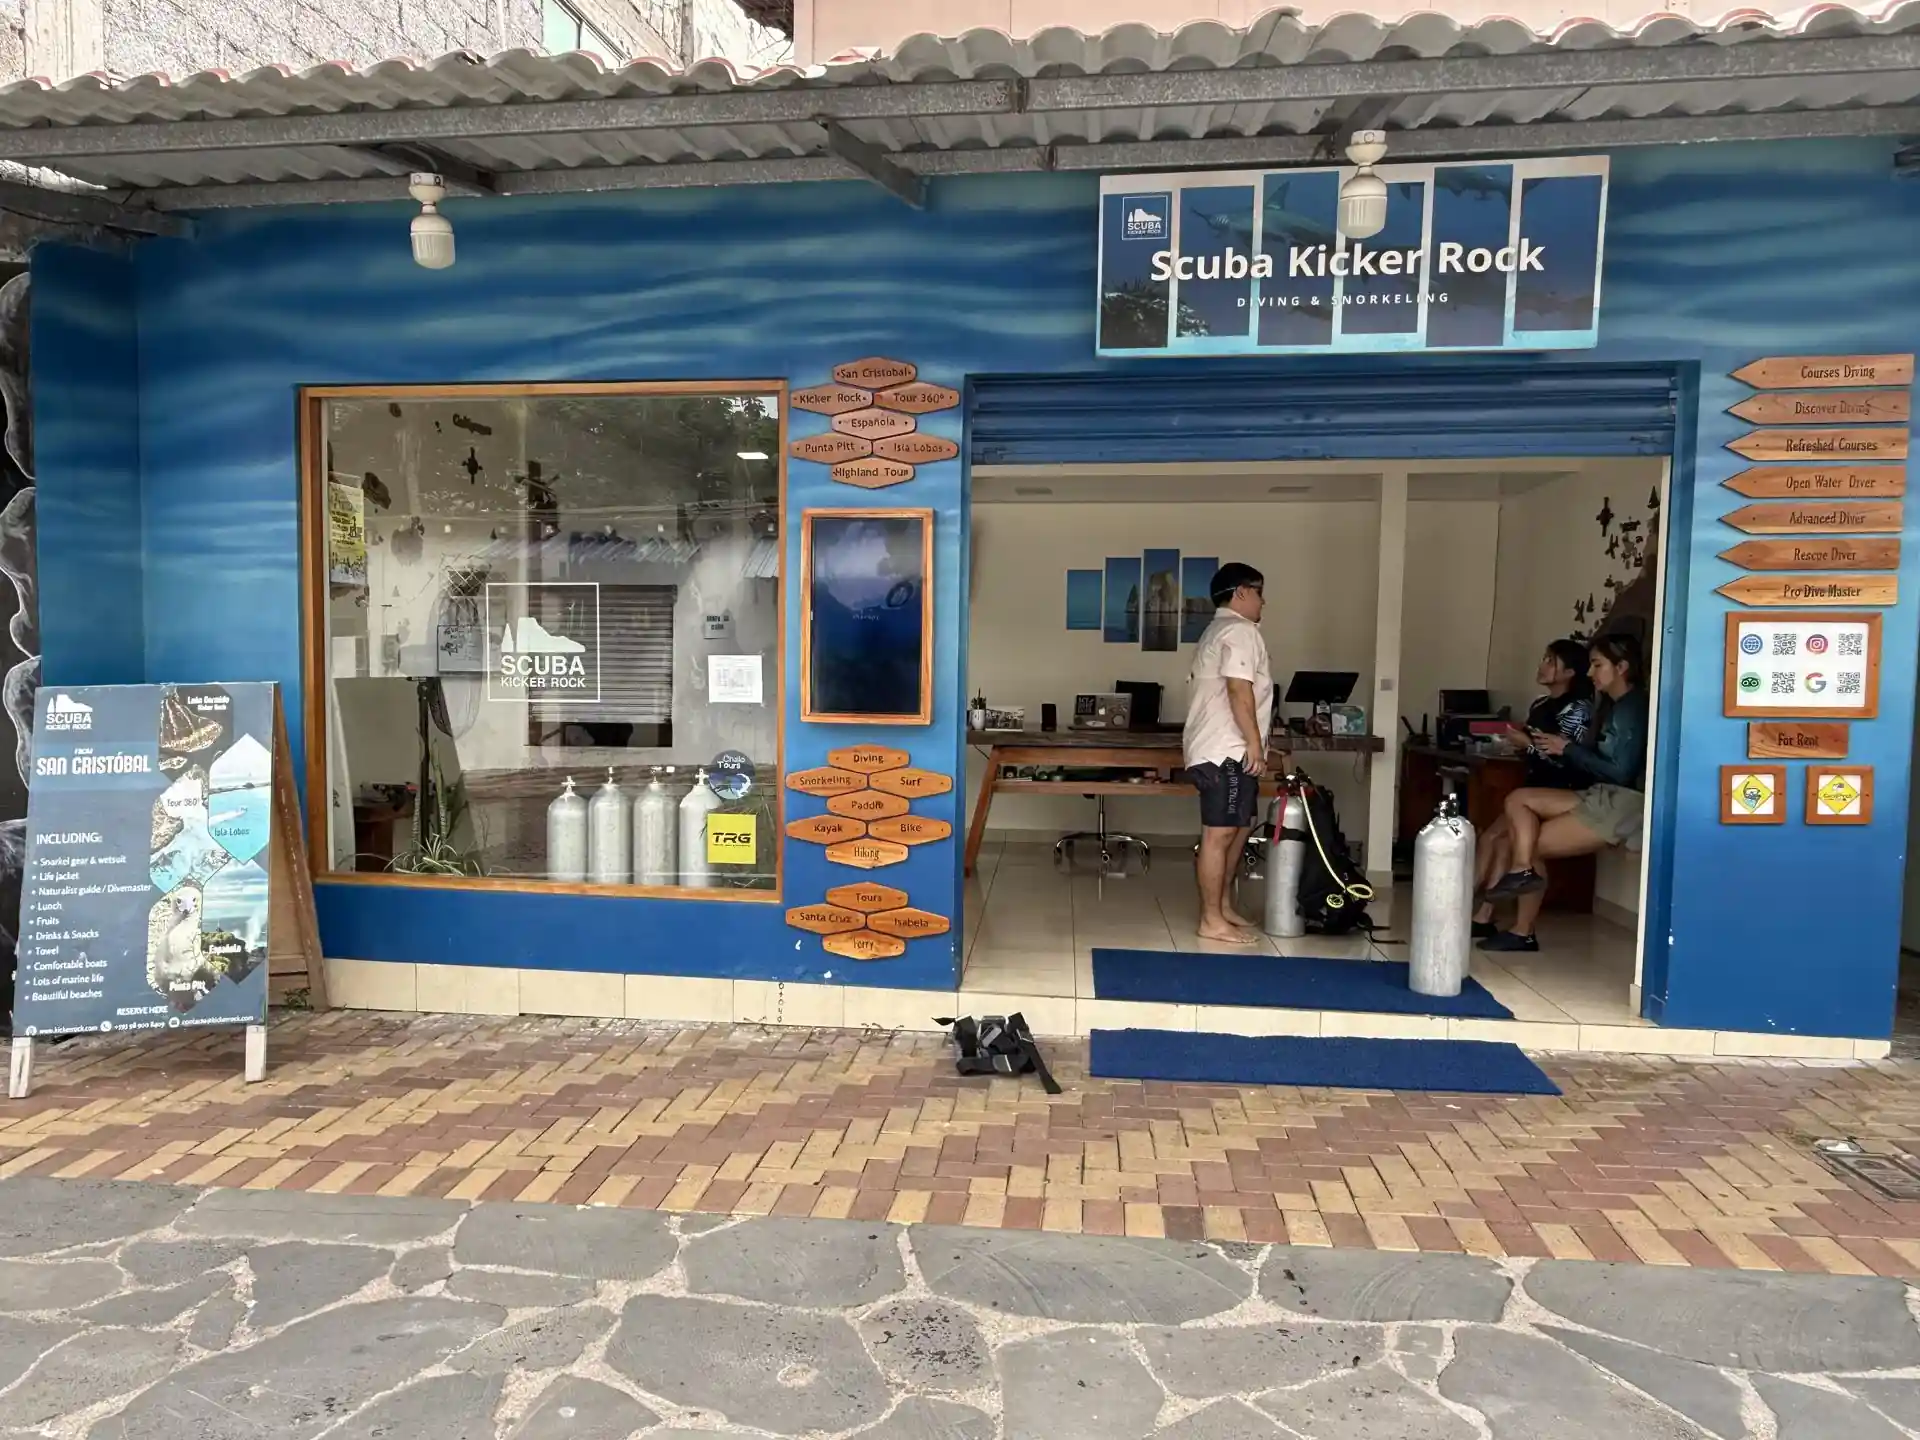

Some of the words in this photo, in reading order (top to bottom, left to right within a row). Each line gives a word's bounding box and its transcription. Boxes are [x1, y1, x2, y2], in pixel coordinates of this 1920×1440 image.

[1127, 221, 1161, 230] SCUBA
[1151, 247, 1273, 281] Scuba
[1289, 243, 1423, 277] Kicker
[1439, 238, 1545, 274] Rock
[1237, 296, 1300, 307] DIVING
[1310, 295, 1320, 306] &
[1331, 292, 1449, 305] SNORKELING
[840, 369, 858, 378] San
[862, 367, 908, 378] Cristobal
[1801, 365, 1840, 379] Courses
[1844, 364, 1875, 380] Diving
[800, 394, 831, 404] Kicker
[837, 393, 861, 403] Rock
[893, 393, 917, 402] Tour
[1795, 401, 1837, 414] Discover
[851, 417, 895, 428] Española
[805, 443, 833, 453] Punta
[836, 441, 856, 451] Pitt
[894, 443, 910, 452] Isla
[914, 443, 943, 453] Lobos
[1785, 437, 1835, 452] Refreshed
[1839, 437, 1878, 451] Courses
[835, 466, 879, 478] Highland
[884, 467, 909, 476] Tour
[1786, 476, 1810, 492] Open
[1814, 476, 1842, 489] Water
[1849, 475, 1876, 488] Diver
[1789, 511, 1836, 524] Advanced
[1839, 511, 1865, 524] Diver
[1794, 548, 1828, 561] Rescue
[1831, 548, 1856, 560] Diver
[1784, 585, 1801, 598] Pro
[1803, 585, 1825, 598] Dive
[1828, 585, 1861, 598] Master
[501, 655, 585, 676] SCUBA
[501, 677, 546, 688] KICKER
[551, 677, 586, 688] ROCK
[46, 713, 92, 724] SCUBA
[1778, 733, 1793, 747] For
[1797, 733, 1819, 747] Rent
[36, 757, 67, 776] SAN
[72, 751, 152, 775] CRISTÓBAL
[717, 761, 741, 769] Tours
[853, 753, 884, 765] Diving
[800, 776, 851, 786] Snorkeling
[900, 776, 922, 786] Surf
[167, 799, 182, 807] Tour
[214, 828, 227, 837] Isla
[229, 827, 250, 836] Lobos
[814, 823, 843, 834] Kayak
[900, 823, 922, 833] Bike
[36, 832, 103, 845] INCLUDING:
[712, 832, 751, 843] TRG
[854, 847, 880, 860] Hiking
[71, 858, 89, 867] gear
[89, 856, 96, 865] &
[97, 855, 127, 864] wetsuit
[39, 872, 54, 881] Life
[55, 871, 80, 882] jacket
[38, 886, 77, 896] Naturalist
[78, 884, 101, 896] guide
[107, 884, 152, 893] Divemaster
[855, 892, 882, 902] Tours
[37, 901, 62, 911] Lunch
[36, 916, 60, 926] Fruits
[800, 912, 826, 922] Santa
[828, 914, 851, 924] Cruz
[894, 918, 929, 928] Isabela
[36, 931, 61, 941] Drinks
[63, 931, 70, 940] &
[71, 929, 99, 939] Snacks
[35, 945, 59, 956] Towel
[33, 960, 84, 971] Comfortable
[85, 958, 108, 968] boats
[32, 977, 50, 986] Lots
[52, 976, 61, 985] of
[62, 975, 90, 984] marine
[91, 973, 104, 983] life
[32, 990, 69, 1001] Beautiful
[70, 989, 103, 999] beaches
